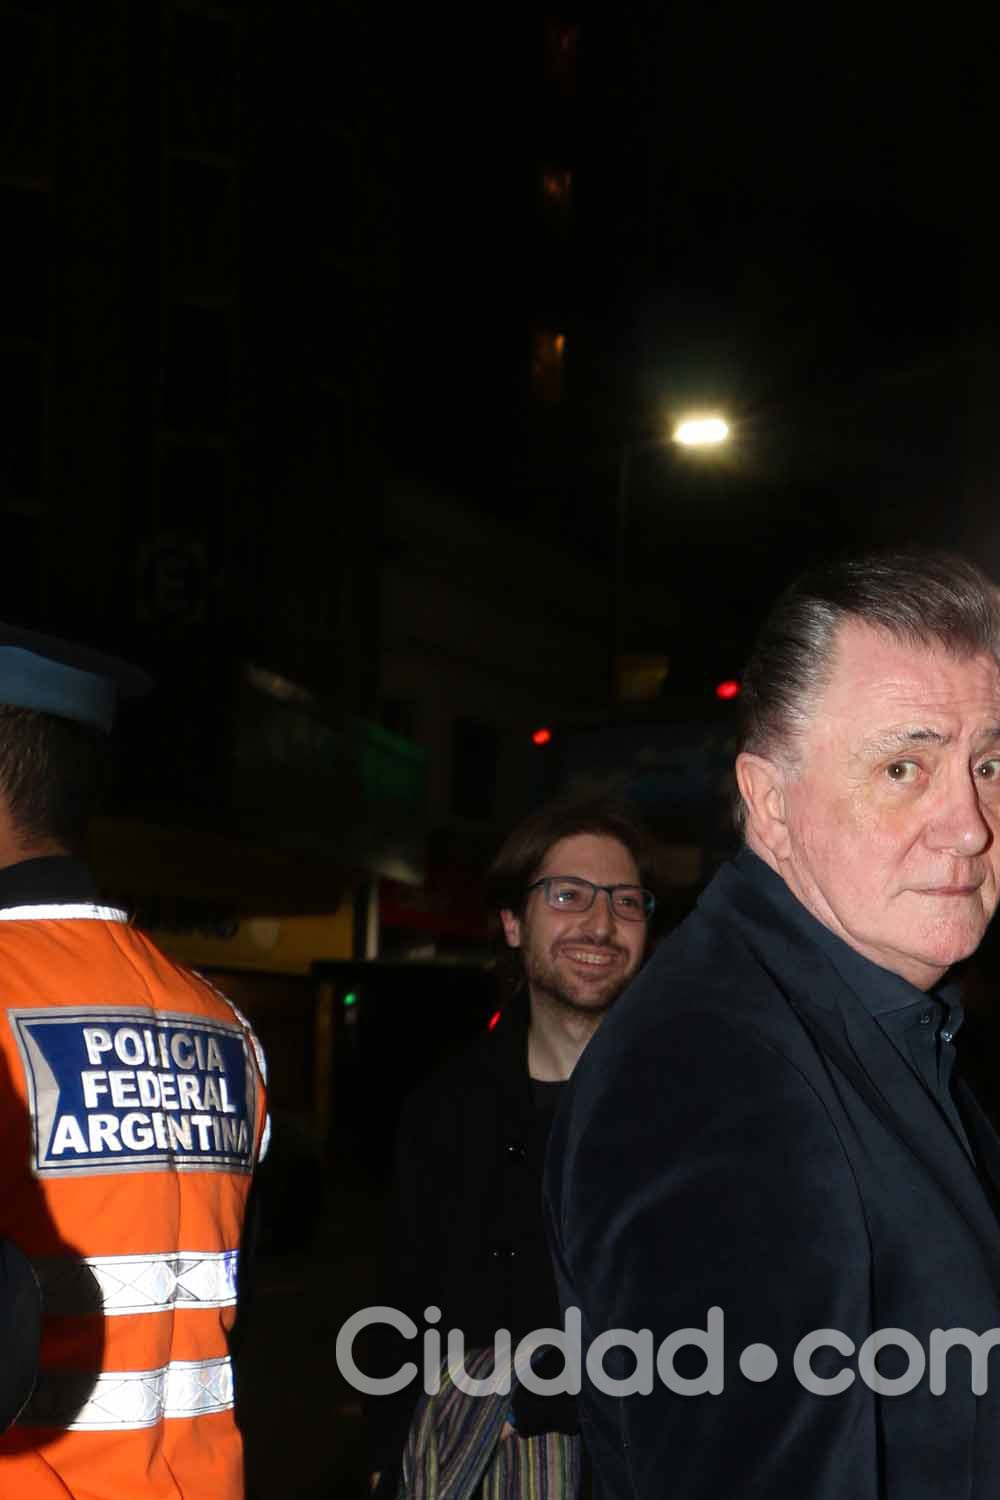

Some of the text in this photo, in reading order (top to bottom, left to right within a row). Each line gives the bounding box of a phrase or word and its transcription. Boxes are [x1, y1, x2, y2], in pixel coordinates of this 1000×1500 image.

[82, 1027, 225, 1073] POLICIA
[80, 1070, 237, 1113] FEDERAL
[51, 1113, 249, 1155] ARGENTINA
